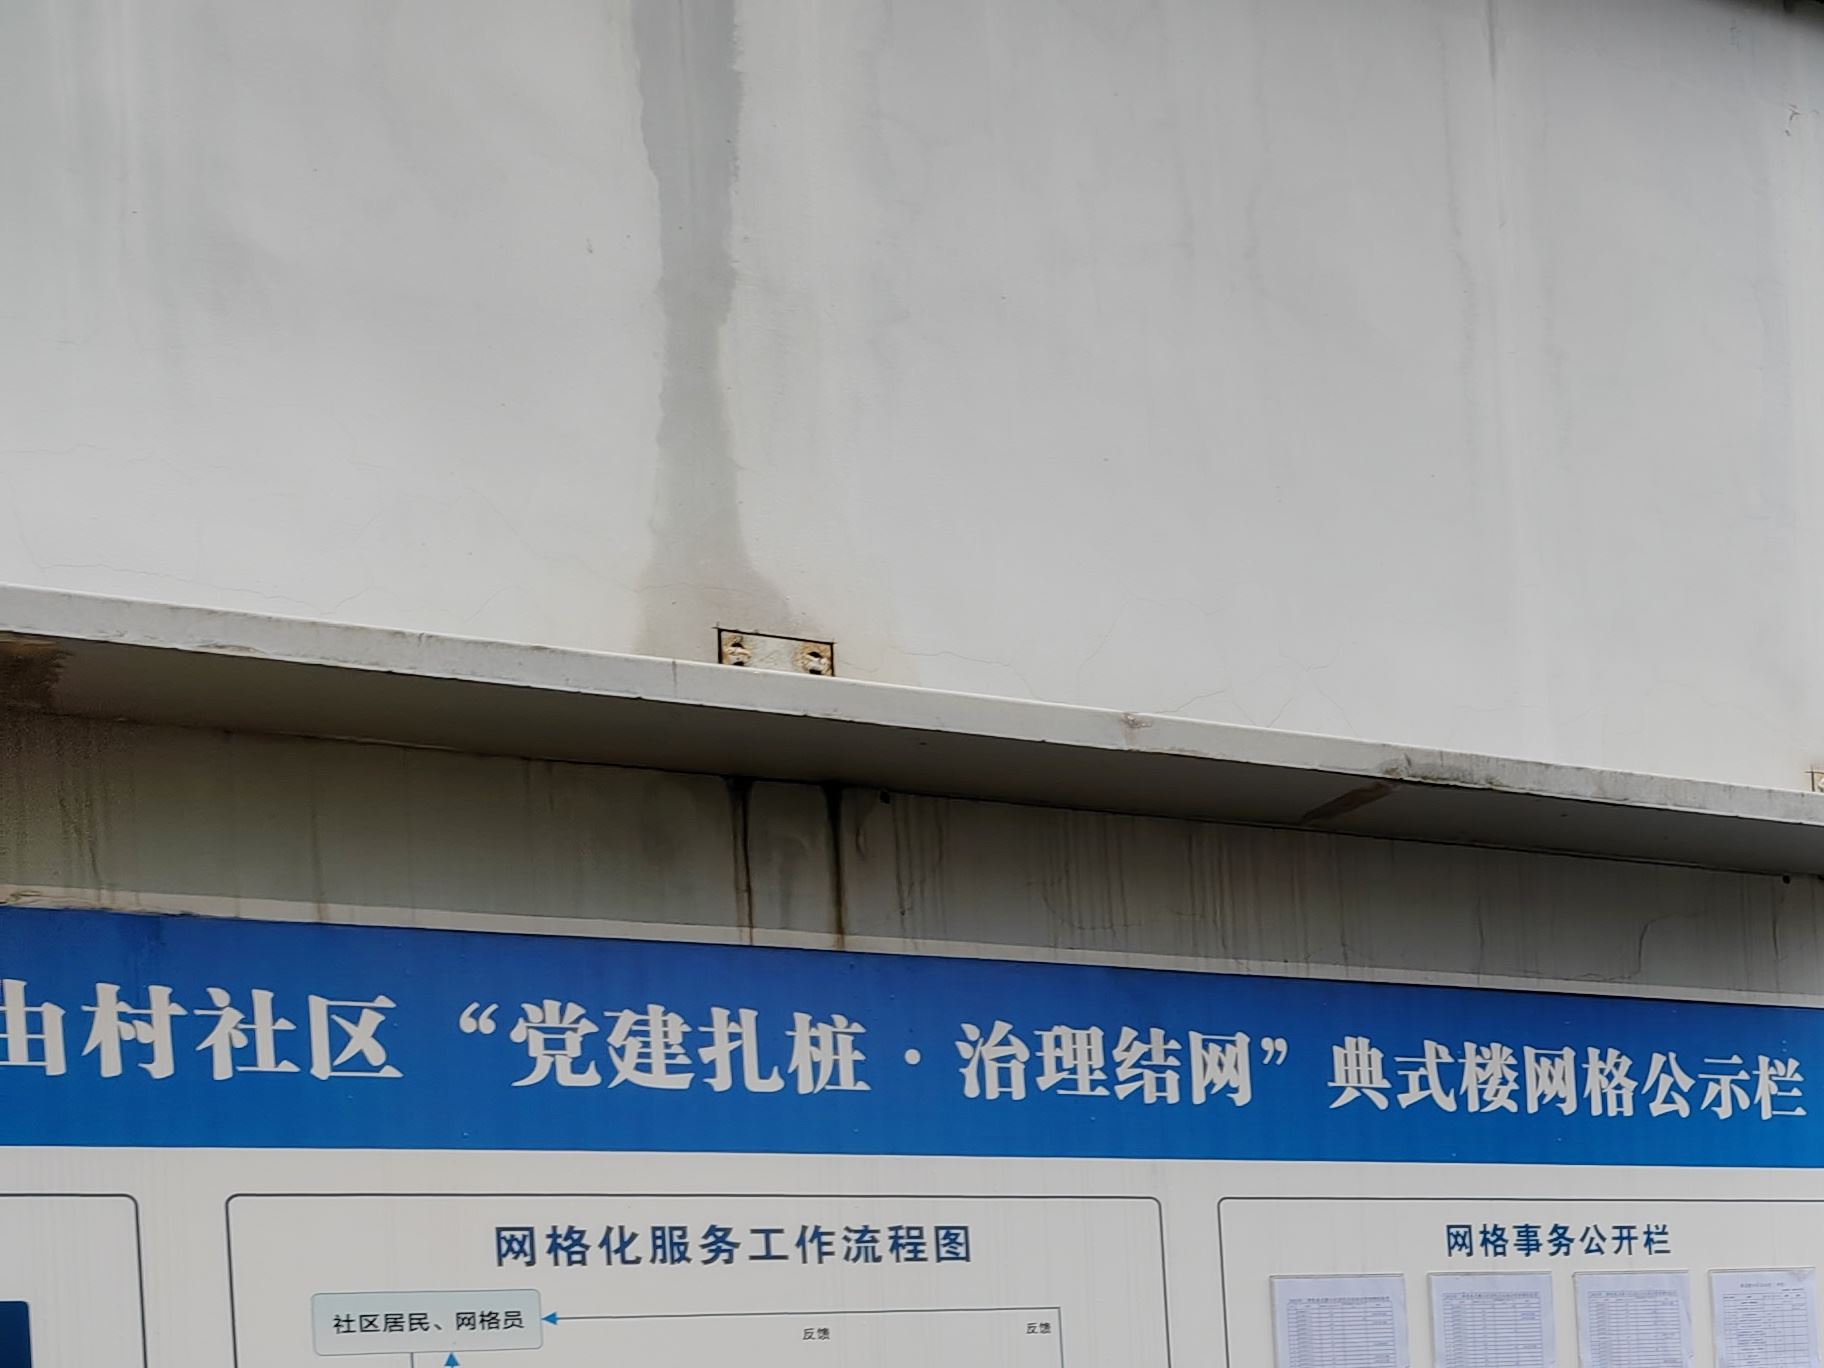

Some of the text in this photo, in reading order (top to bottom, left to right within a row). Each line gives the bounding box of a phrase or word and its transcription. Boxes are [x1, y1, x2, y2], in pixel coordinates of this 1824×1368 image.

[494, 1224, 971, 1268] 网格化服务工作流程图
[1445, 1223, 1671, 1258] 网格事务公开栏
[333, 1310, 525, 1335] 社区居民、网格员
[802, 1327, 831, 1341] 反馈
[1026, 1322, 1052, 1335] 反馈
